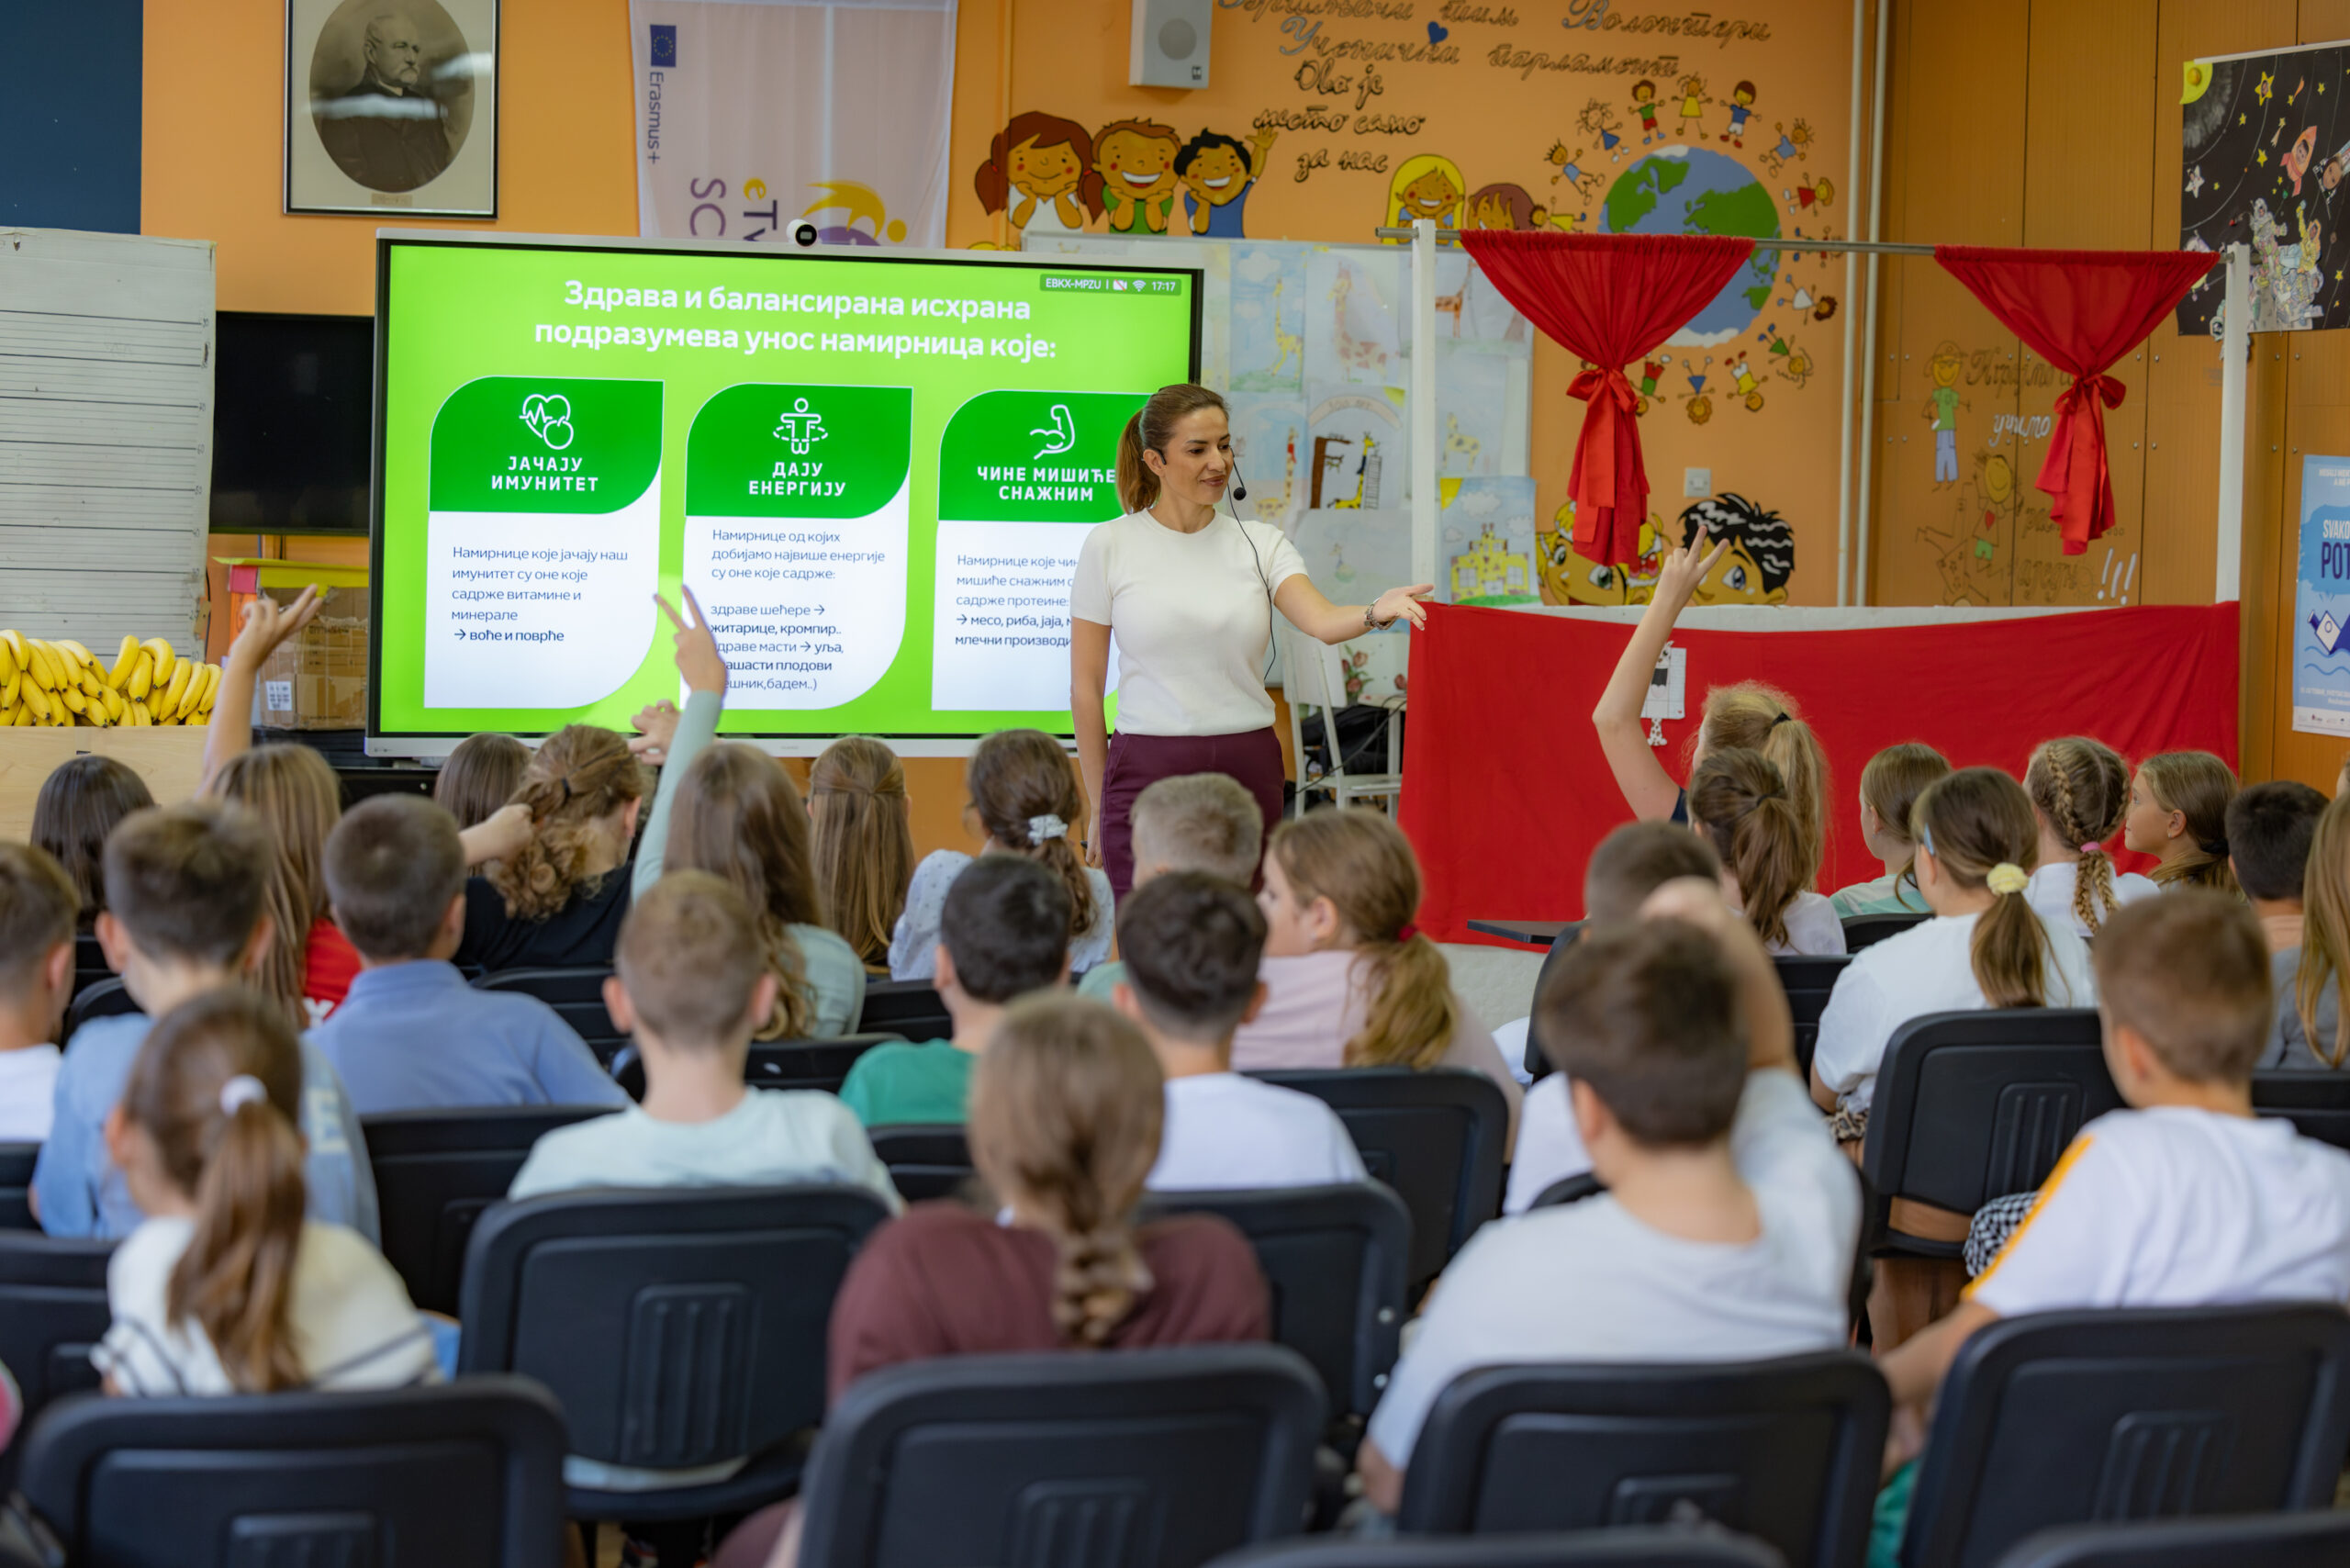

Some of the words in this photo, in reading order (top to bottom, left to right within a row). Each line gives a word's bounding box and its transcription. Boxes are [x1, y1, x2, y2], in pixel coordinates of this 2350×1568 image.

[1561, 0, 1772, 49] Волонтери
[1279, 16, 1460, 64] Ученички
[647, 71, 665, 165] Erasmus+
[1354, 113, 1427, 135] само
[1294, 148, 1330, 183] за
[1337, 150, 1389, 174] нас
[1045, 277, 1102, 290] EBKX-MPZU
[1151, 280, 1177, 292] 17:17
[565, 280, 677, 312] Здрава
[685, 291, 702, 308] и
[709, 286, 904, 319] балансирана
[912, 296, 1031, 323] исхрана
[535, 324, 738, 352] подразумева
[744, 330, 814, 354] унос
[821, 333, 984, 359] намирница
[990, 336, 1057, 364] које:
[508, 456, 583, 472] ЈАЧАЈУ
[772, 462, 823, 479] ДАЈУ
[977, 466, 1026, 481] ЧИНЕ
[1033, 467, 1116, 484] МИШИЋЕ
[491, 476, 599, 492] ИМУНИТЕТ
[748, 480, 846, 497] ЕНЕРГИЈУ
[999, 486, 1093, 501] СНАЖНИМ
[712, 529, 787, 543] Намирнице
[789, 532, 805, 543] од
[808, 531, 841, 544] којих
[2322, 519, 2350, 540] SVAKO
[453, 547, 530, 562] Намирнице
[533, 548, 559, 562] које
[560, 549, 598, 563] јачају
[600, 551, 628, 561] наш
[711, 549, 772, 563] добијамо
[774, 549, 827, 563] највише
[829, 551, 885, 564] енергије
[957, 554, 1028, 568] Намирнице
[1031, 556, 1056, 569] које
[452, 569, 515, 582] имунитет
[517, 571, 532, 583] су
[535, 570, 559, 580] оне
[562, 568, 588, 582] које
[711, 568, 726, 580] су
[728, 569, 752, 578] оне
[754, 567, 780, 580] које
[782, 569, 836, 582] садрже:
[957, 575, 1007, 587] мишиће
[1009, 577, 1065, 587] снажним
[452, 590, 505, 603] садрже
[507, 590, 571, 600] витамине
[573, 591, 581, 600] и
[956, 597, 1005, 608] садрже
[1007, 598, 1069, 608] протеине:
[452, 610, 518, 622] минерале
[711, 606, 758, 617] здраве
[760, 604, 811, 617] шећере
[970, 616, 1004, 627] месо,
[1006, 615, 1039, 628] риба,
[1040, 615, 1064, 629] јаја,
[470, 629, 502, 642] воће
[505, 632, 513, 642] и
[515, 630, 565, 644] поврће
[711, 624, 778, 635] житарице,
[780, 625, 843, 636] кромпир..
[955, 636, 1002, 645] млечни
[716, 643, 757, 654] драве
[759, 644, 798, 653] масти
[814, 644, 845, 655] уља,
[725, 661, 774, 671] ашасти
[776, 661, 833, 672] плодови
